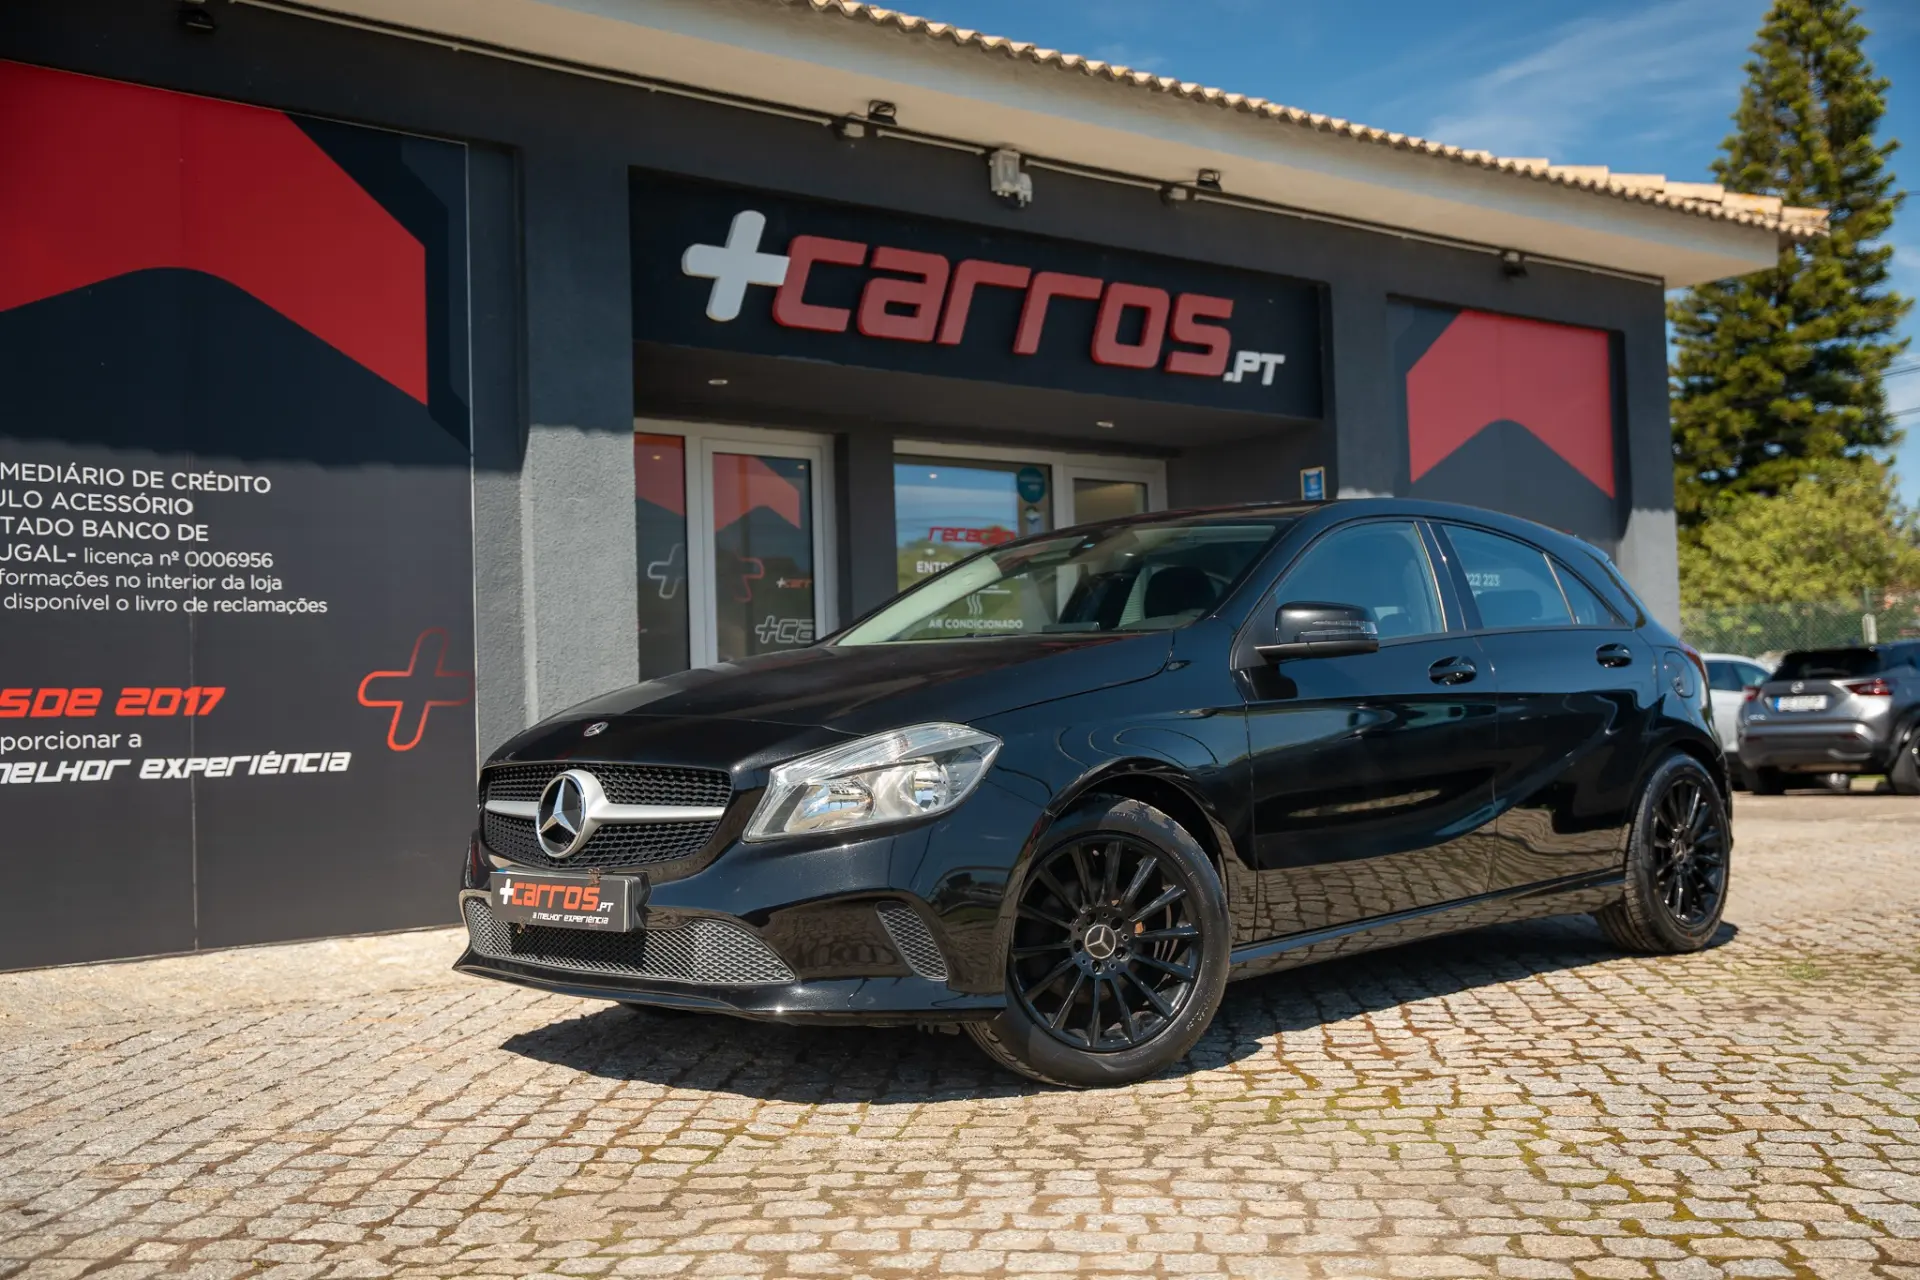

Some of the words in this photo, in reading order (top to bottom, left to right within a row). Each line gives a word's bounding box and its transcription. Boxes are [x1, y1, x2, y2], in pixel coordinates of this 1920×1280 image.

[0, 461, 125, 487] MEDIÁRIO
[132, 470, 164, 489] DE
[171, 470, 272, 494] CRÉDITO
[51, 492, 194, 516] ACESSÓRIO
[82, 519, 171, 541] BANCO
[177, 524, 209, 542] DE
[84, 547, 154, 567] licença
[159, 551, 180, 566] nº
[184, 551, 274, 568] 0006956
[115, 574, 141, 587] no
[147, 572, 216, 590] interior
[221, 575, 245, 591] da
[250, 574, 283, 593] loja
[4, 592, 110, 613] disponível
[116, 598, 129, 612] o
[135, 595, 178, 613] livro
[183, 597, 208, 614] de
[213, 598, 328, 616] reclamações
[115, 687, 226, 717] 2017
[0, 730, 121, 755] porcionar
[128, 733, 142, 749] a
